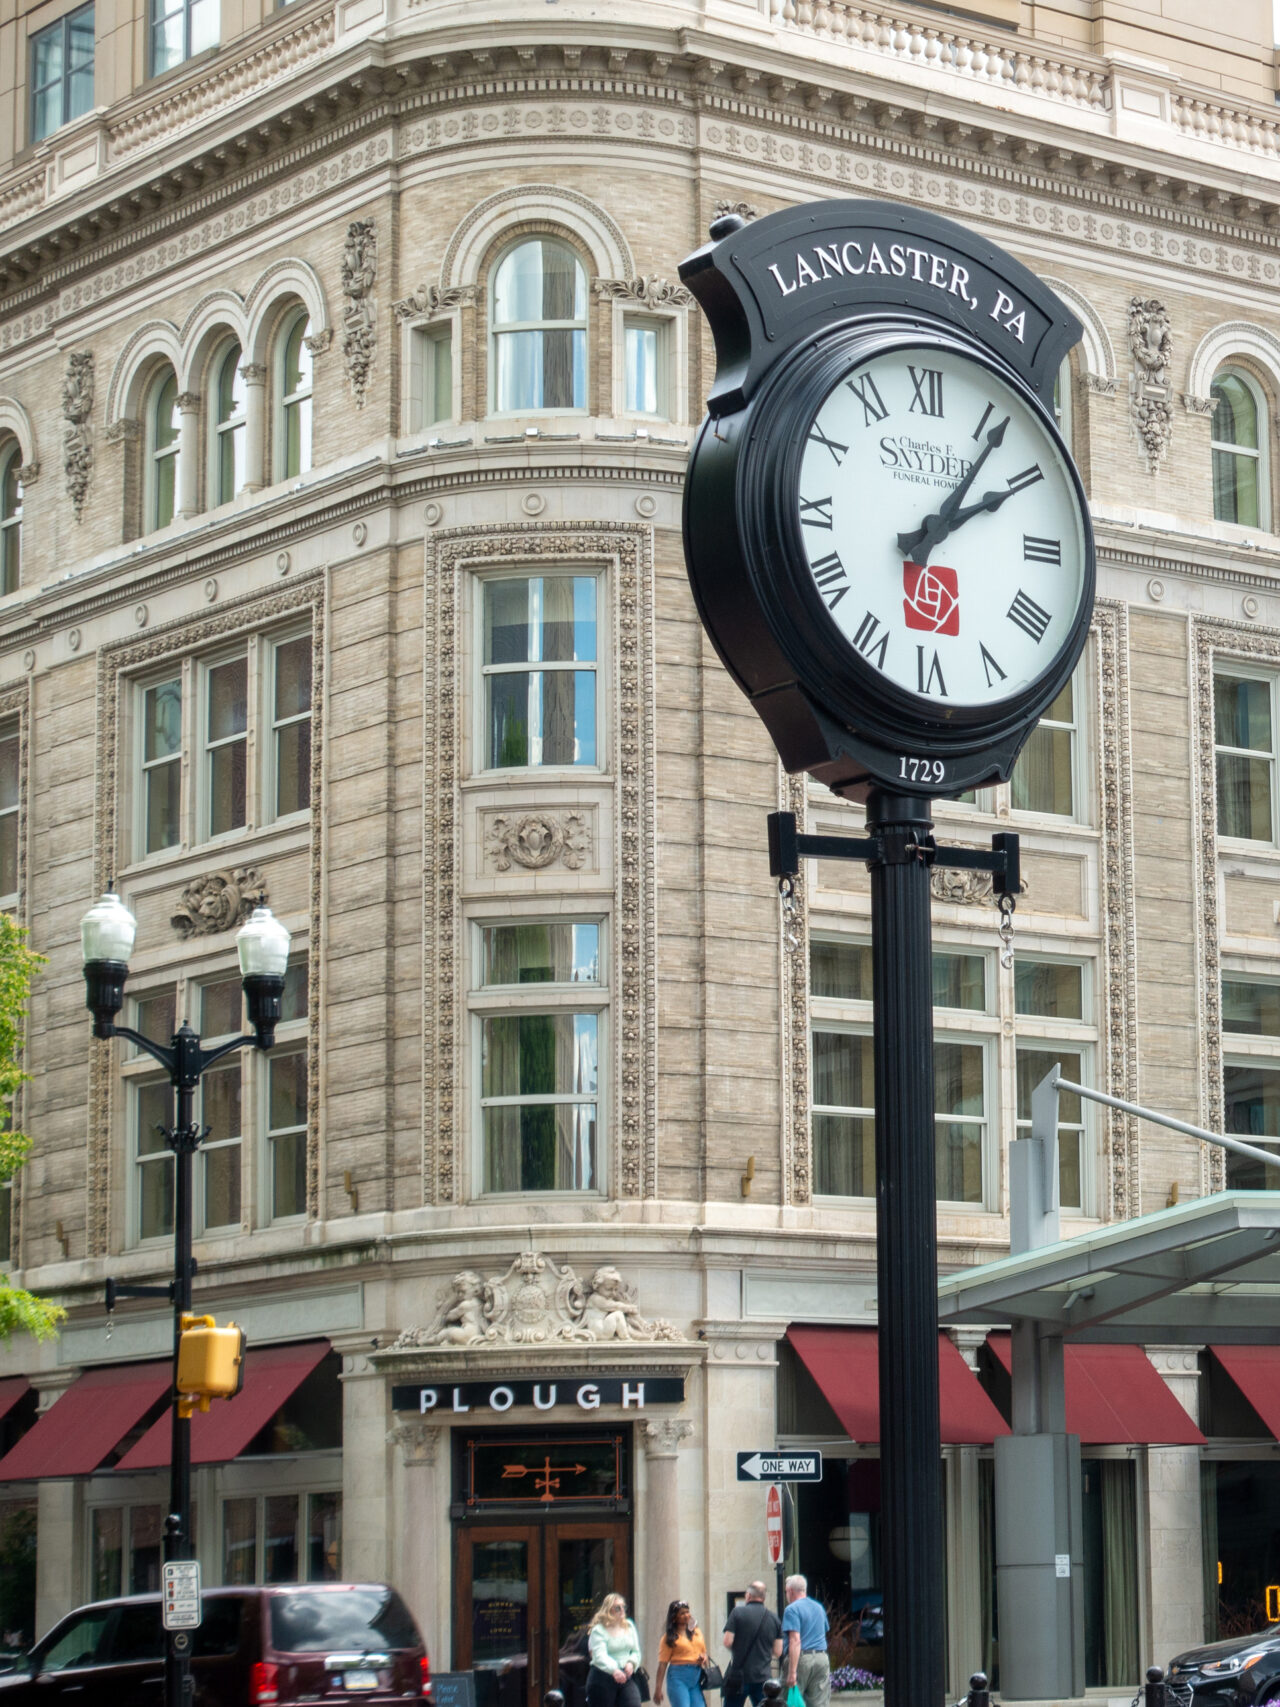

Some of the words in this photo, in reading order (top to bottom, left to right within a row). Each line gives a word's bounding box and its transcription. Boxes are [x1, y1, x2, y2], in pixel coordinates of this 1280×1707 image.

[767, 241, 978, 310] LANCASTER,
[989, 289, 1027, 343] PA
[845, 371, 890, 427] XI
[906, 365, 945, 418] XII
[879, 436, 974, 479] SNYDER
[899, 435, 942, 454] Charles
[945, 444, 955, 457] F.
[892, 471, 930, 486] FUNERAL
[899, 756, 945, 783] 1729
[420, 1383, 645, 1414] PLOUGH
[762, 1461, 784, 1472] ONE
[788, 1461, 812, 1471] WAY
